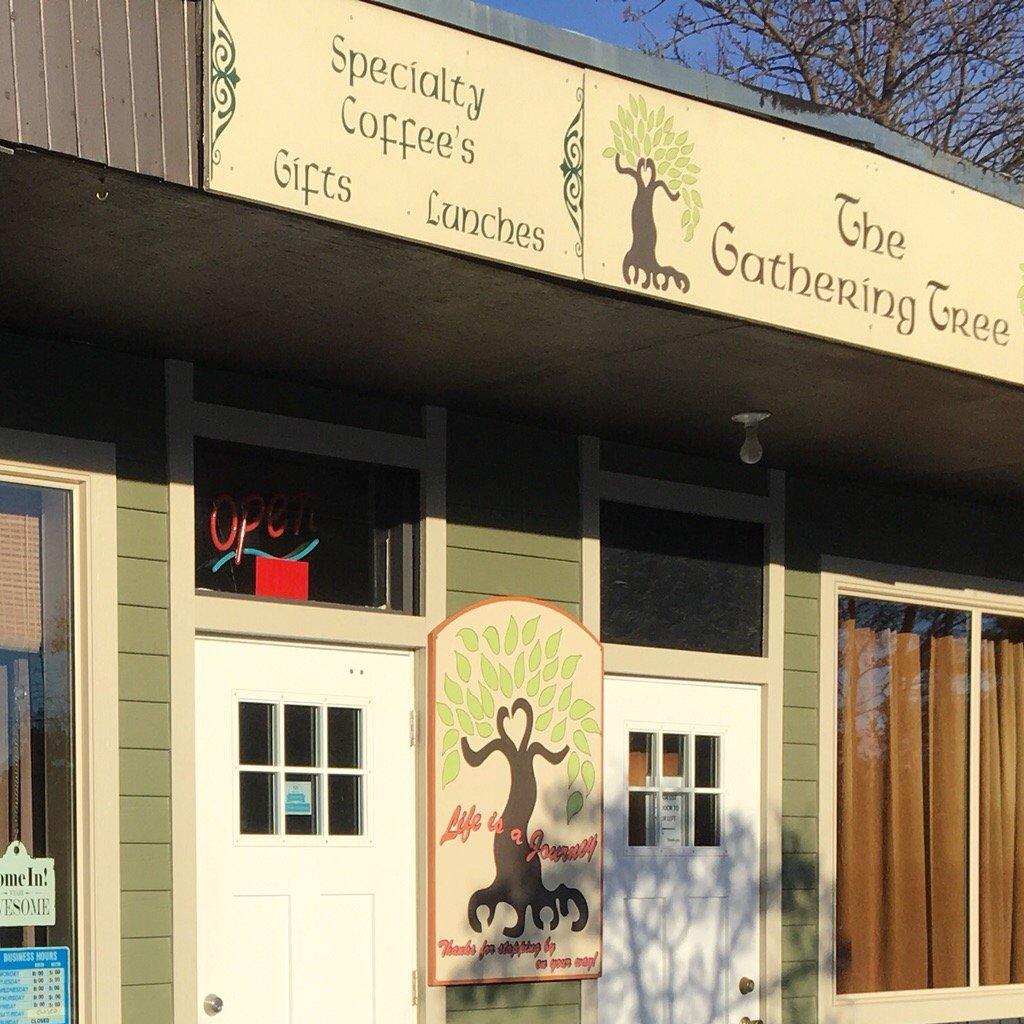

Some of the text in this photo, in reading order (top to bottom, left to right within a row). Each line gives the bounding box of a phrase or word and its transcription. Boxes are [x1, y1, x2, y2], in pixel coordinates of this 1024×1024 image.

[331, 34, 485, 121] Specialty
[340, 95, 476, 164] Coffee's
[273, 148, 352, 206] Gifts
[426, 189, 546, 253] Lunches
[834, 192, 907, 260] The
[711, 221, 1011, 347] Gathering Tree
[439, 804, 482, 847] Life
[487, 811, 505, 834] is
[510, 827, 524, 845] a
[27, 866, 48, 887] In!
[3, 951, 58, 963] BUSINESS HOURS
[438, 936, 556, 961] Thanks for stopping by
